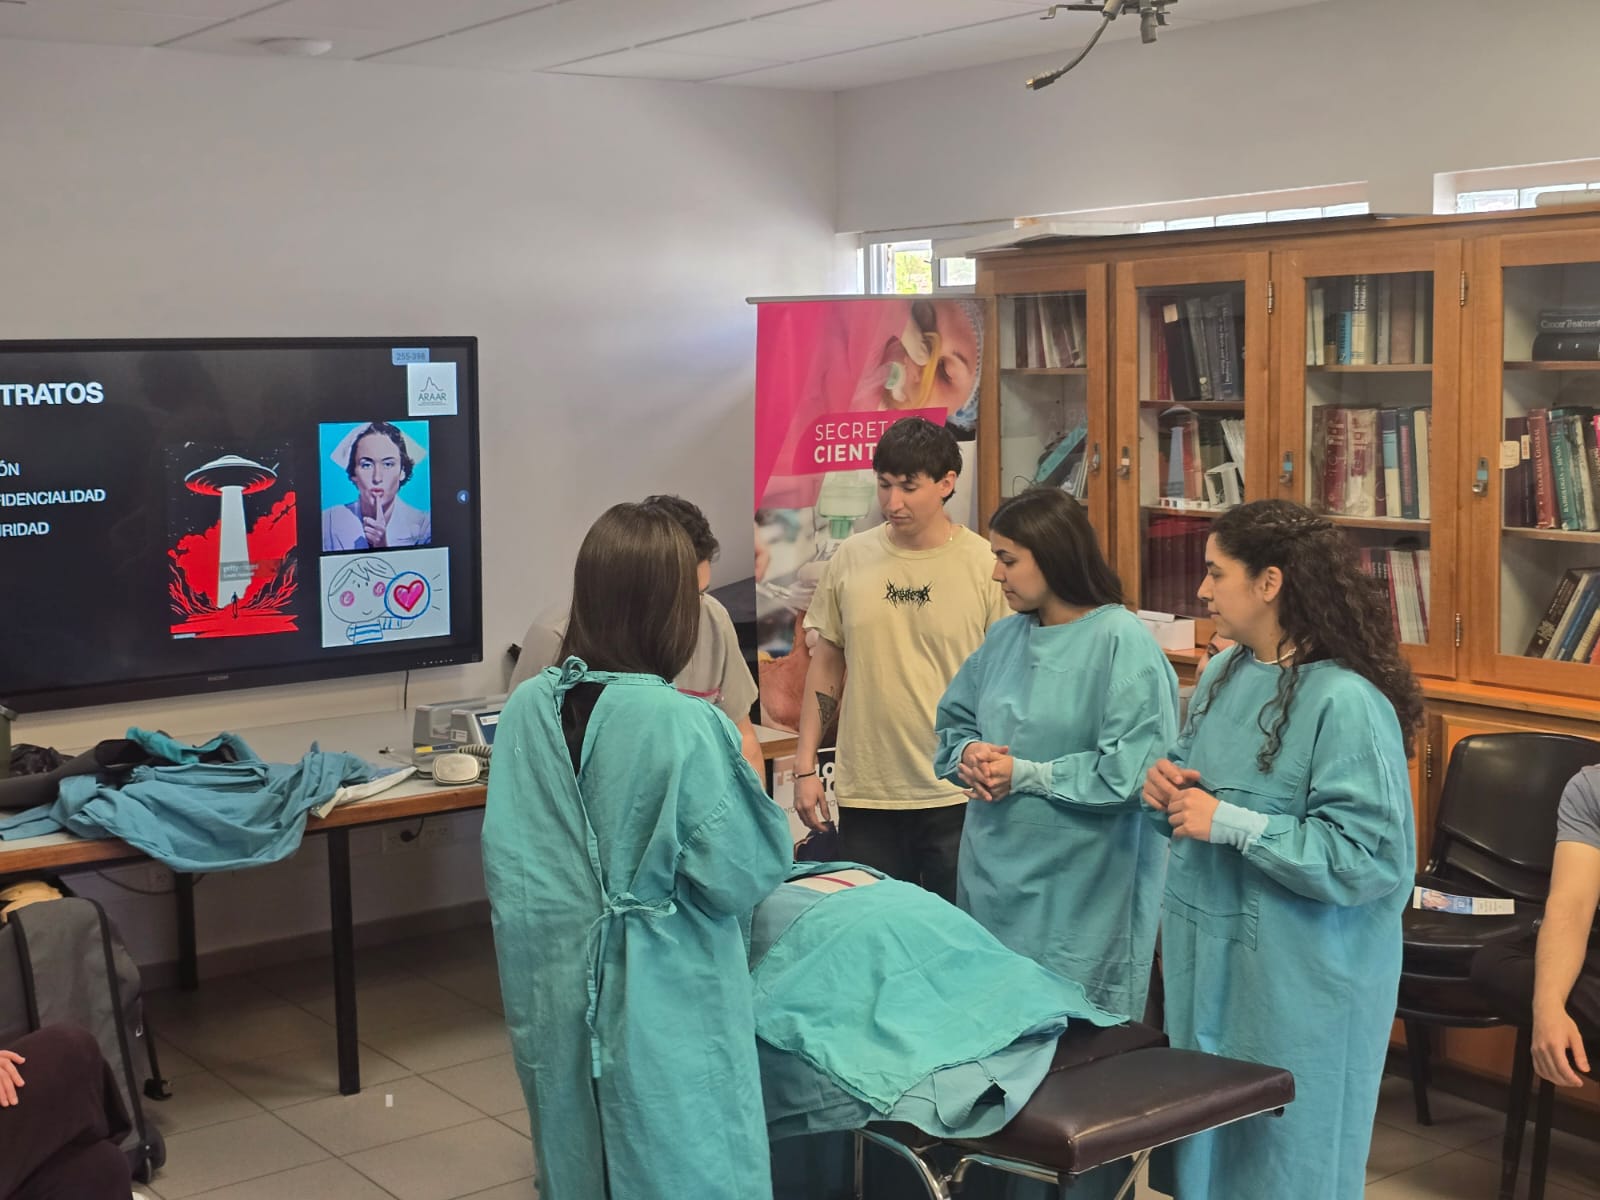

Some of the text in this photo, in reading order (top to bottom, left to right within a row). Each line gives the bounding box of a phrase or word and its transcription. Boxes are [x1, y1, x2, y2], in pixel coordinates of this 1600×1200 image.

[0, 382, 104, 405] TRATOS
[815, 420, 893, 441] SECRET
[0, 489, 106, 507] IDENCIALIDAD
[0, 522, 51, 537] RIDAD
